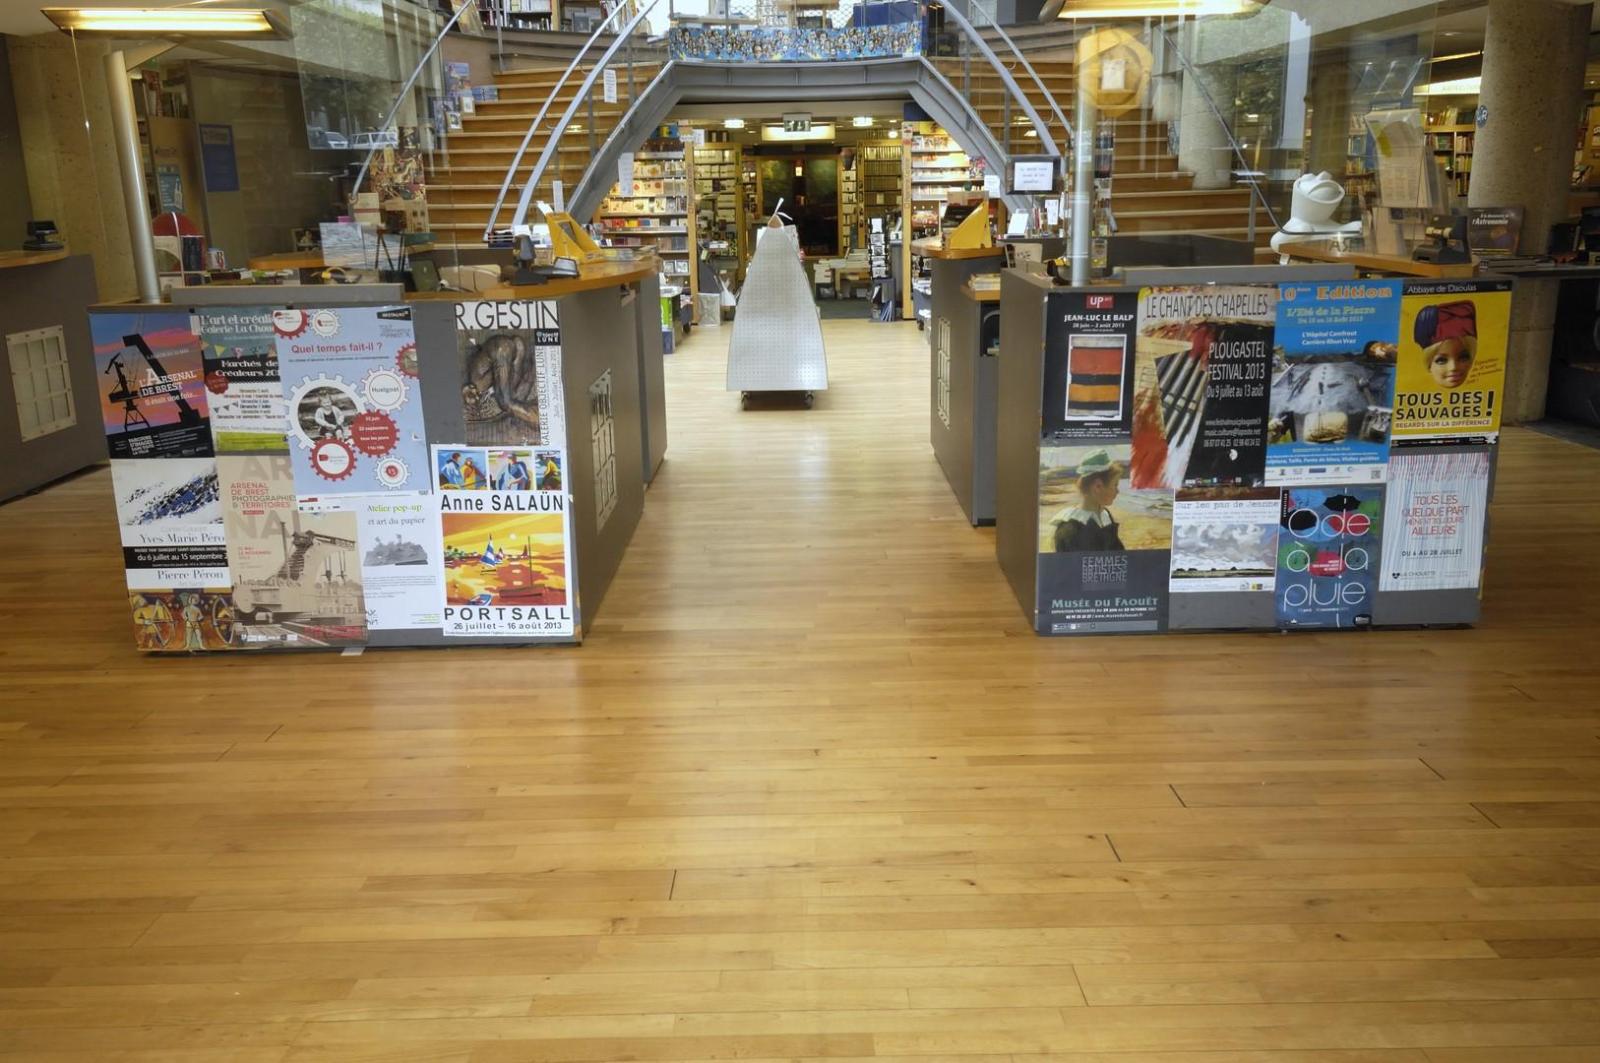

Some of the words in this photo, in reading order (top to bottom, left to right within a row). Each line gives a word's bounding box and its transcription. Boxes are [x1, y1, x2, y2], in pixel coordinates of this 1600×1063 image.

[1316, 284, 1393, 299] Edition
[1407, 285, 1435, 297] Abbaye
[1436, 285, 1445, 293] de
[1448, 284, 1477, 292] Daoulas
[1090, 296, 1104, 308] UP
[1147, 296, 1157, 318] LE
[1160, 295, 1194, 318] CHANT
[1196, 295, 1213, 317] DES
[1216, 293, 1268, 316] CHAPELLES
[1316, 307, 1329, 316] de
[1064, 314, 1101, 322] JEAN-LUC
[292, 344, 314, 354] Quel
[317, 343, 347, 354] temps
[349, 342, 374, 352] fait-il
[377, 342, 383, 350] ?
[1209, 341, 1266, 359] PLOUGASTEL
[535, 346, 545, 368] LUNE
[265, 360, 279, 368] de
[215, 368, 264, 377] Créateurs
[1208, 363, 1244, 380] FESTIVAL
[1246, 362, 1265, 379] 2013
[142, 387, 156, 397] DE
[156, 382, 184, 395] BREST
[536, 370, 547, 409] OBJECTIF
[1236, 387, 1243, 396] au
[1397, 392, 1443, 407] TOUS
[1450, 391, 1483, 405] DES
[1396, 405, 1481, 420] SAUVAGES
[1486, 391, 1495, 417] !
[541, 413, 549, 446] GALERIE
[1395, 421, 1425, 429] REGARDS
[1427, 420, 1440, 428] SUR
[1441, 420, 1450, 428] LA
[231, 482, 269, 490] ARSENAL
[441, 494, 484, 511] Anne
[492, 491, 564, 511] SALAÜN
[1415, 494, 1440, 506] TOUS
[1441, 494, 1458, 504] LES
[393, 504, 422, 513] pop-up
[1402, 507, 1444, 517] QUELQUE
[1445, 505, 1470, 517] PART
[401, 518, 425, 526] papier
[1412, 526, 1457, 536] AILLEURS
[140, 533, 164, 544] Yves
[168, 532, 198, 543] Marie
[189, 553, 223, 561] septembre
[1439, 548, 1463, 556] JUILLET
[1082, 555, 1128, 566] FEMMES
[157, 569, 190, 580] Pierre
[193, 568, 224, 579] Péron
[1283, 577, 1366, 612] pluie
[1095, 598, 1110, 607] DU
[444, 607, 571, 620] PORTSALL
[454, 622, 463, 630] 26
[465, 622, 496, 631] juillet
[519, 621, 542, 630] août
[544, 621, 562, 629] 2013
